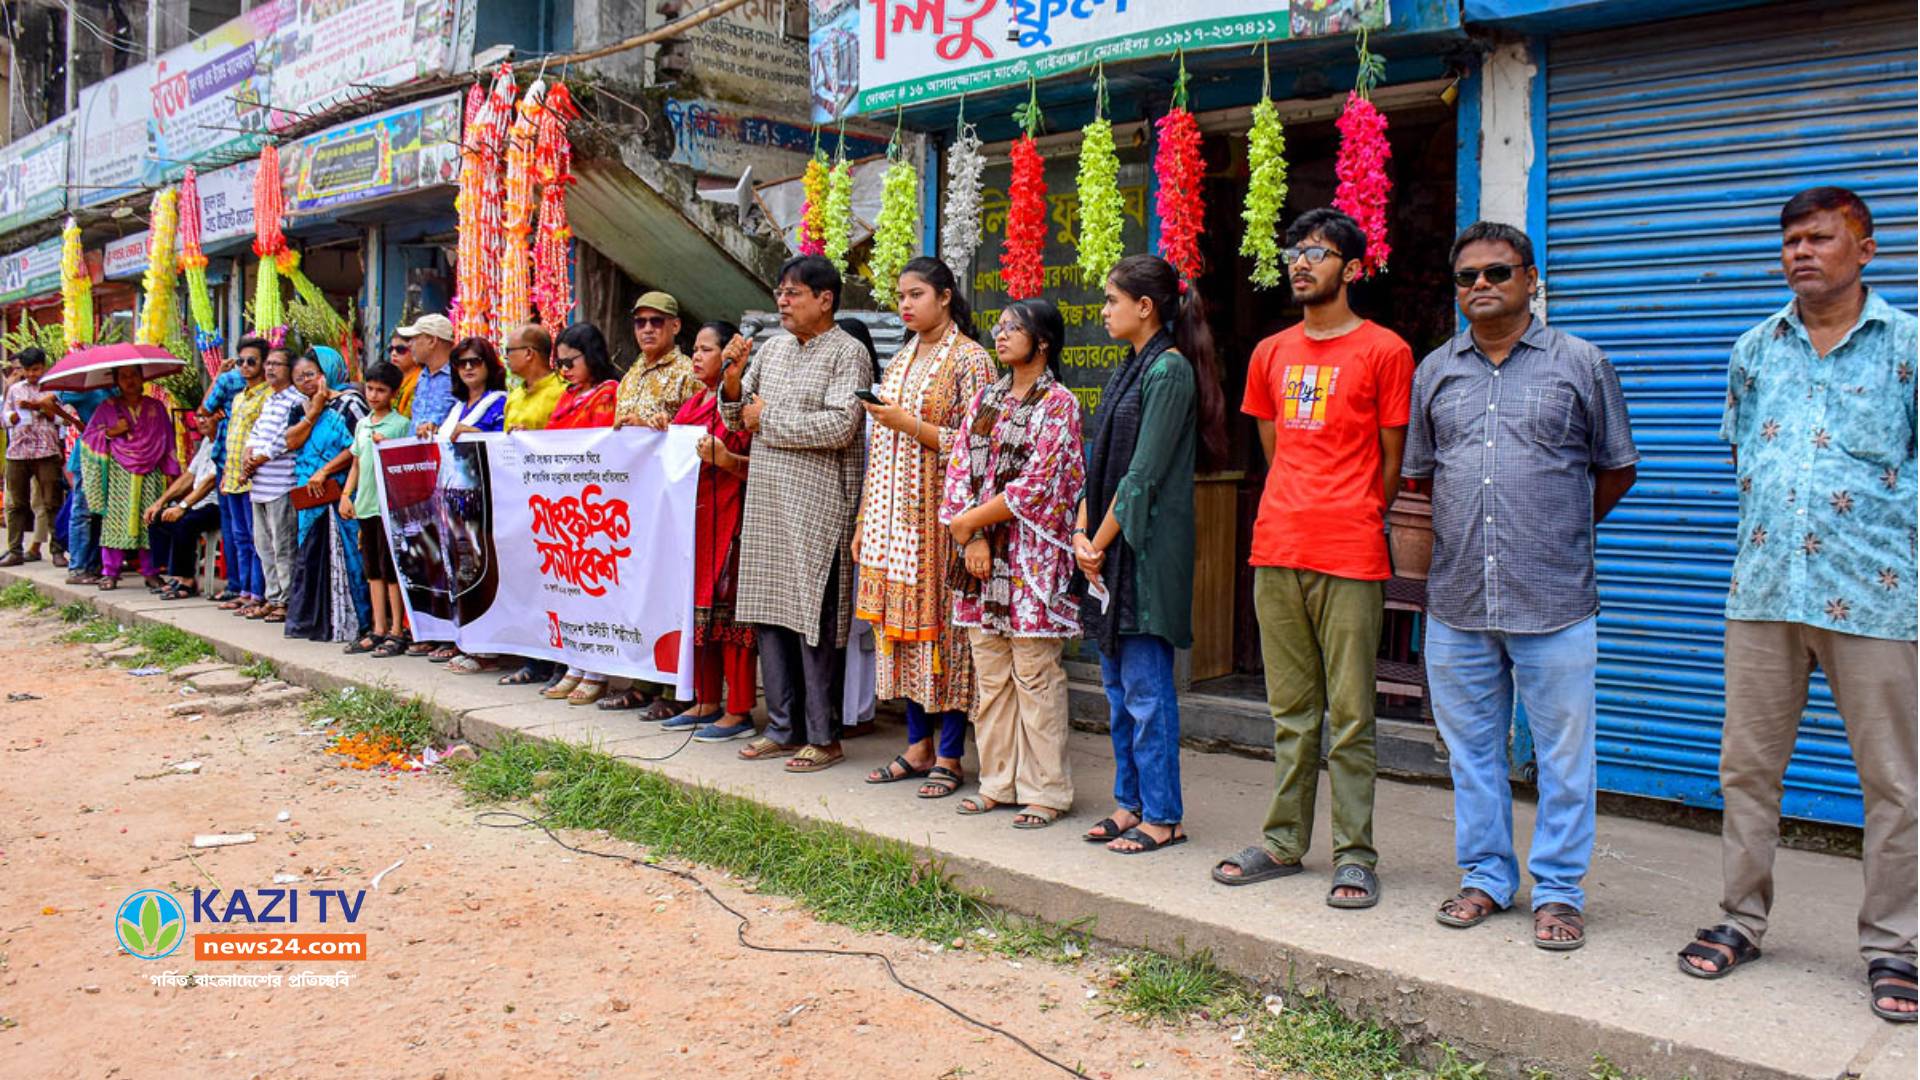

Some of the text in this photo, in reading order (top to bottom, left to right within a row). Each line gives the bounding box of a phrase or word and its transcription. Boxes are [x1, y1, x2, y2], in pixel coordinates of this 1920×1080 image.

[865, 88, 897, 106] দোকান
[908, 84, 923, 97] ১৬
[926, 71, 991, 92] আসাদুজ্জামান
[528, 484, 632, 548] সাংস্কৃতিক
[533, 539, 632, 597] সমাবেশ
